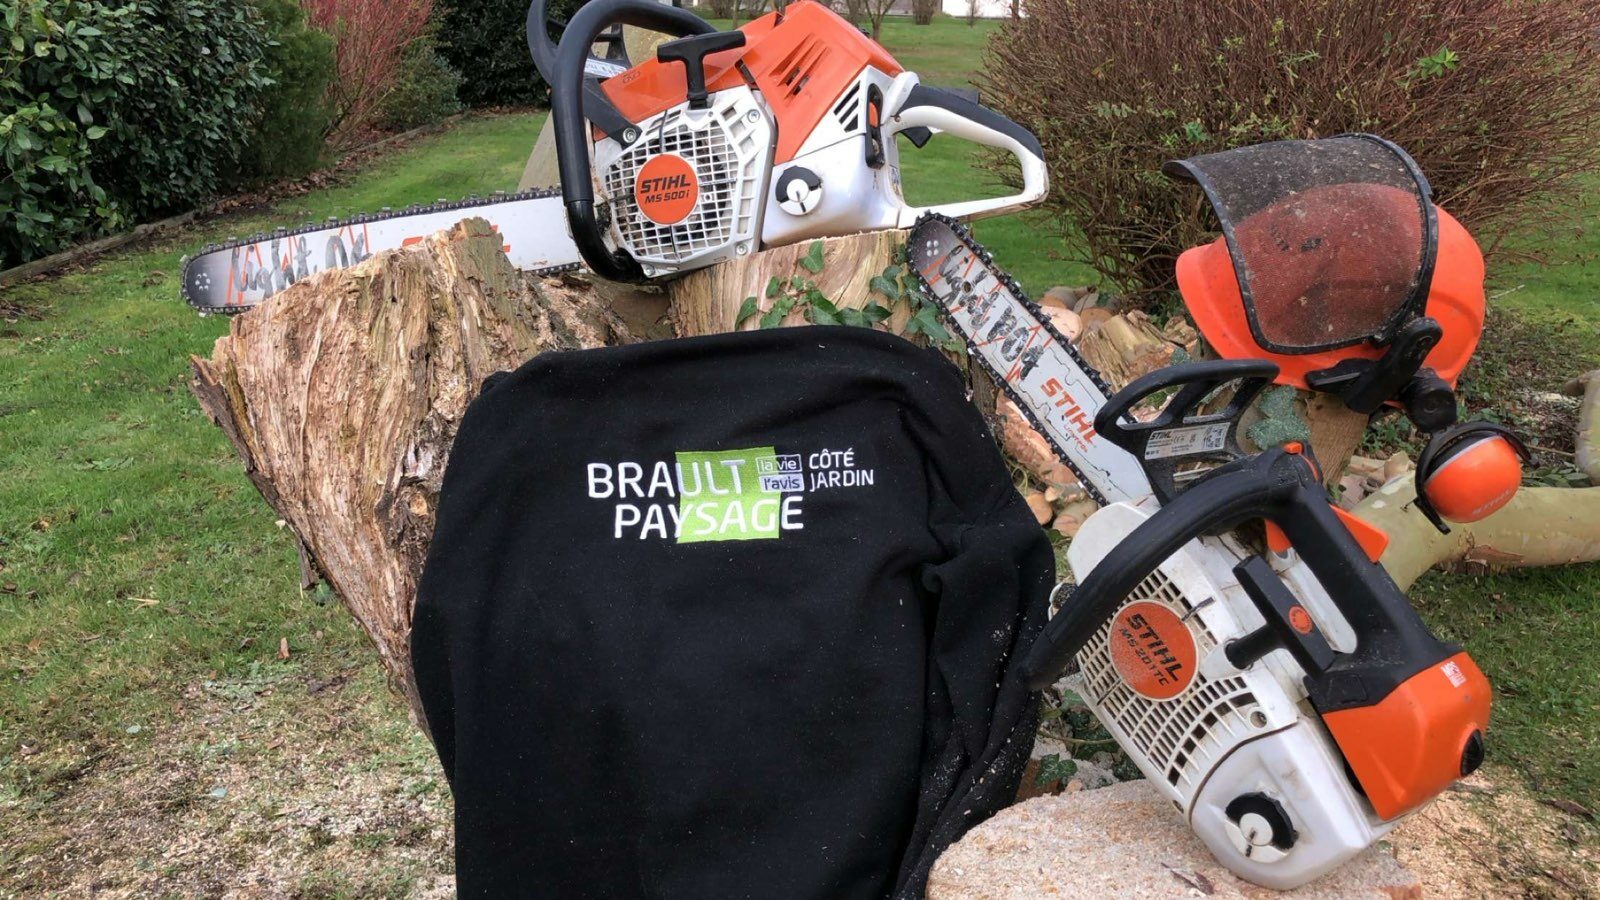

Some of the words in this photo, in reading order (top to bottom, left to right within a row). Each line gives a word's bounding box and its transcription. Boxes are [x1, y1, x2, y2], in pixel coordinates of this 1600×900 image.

[641, 174, 691, 194] STIHL
[645, 193, 662, 204] MS
[664, 190, 690, 202] 500i
[1041, 377, 1098, 445] STIHL
[760, 460, 774, 472] la
[776, 457, 797, 470] vie
[809, 448, 855, 469] CÔTÉ
[587, 459, 745, 498] BRAULT
[764, 476, 800, 491] l'avis
[809, 469, 874, 492] JARDIN
[614, 496, 804, 539] PAYSAGE
[1119, 628, 1138, 648] MS
[1126, 613, 1183, 682] STIHL
